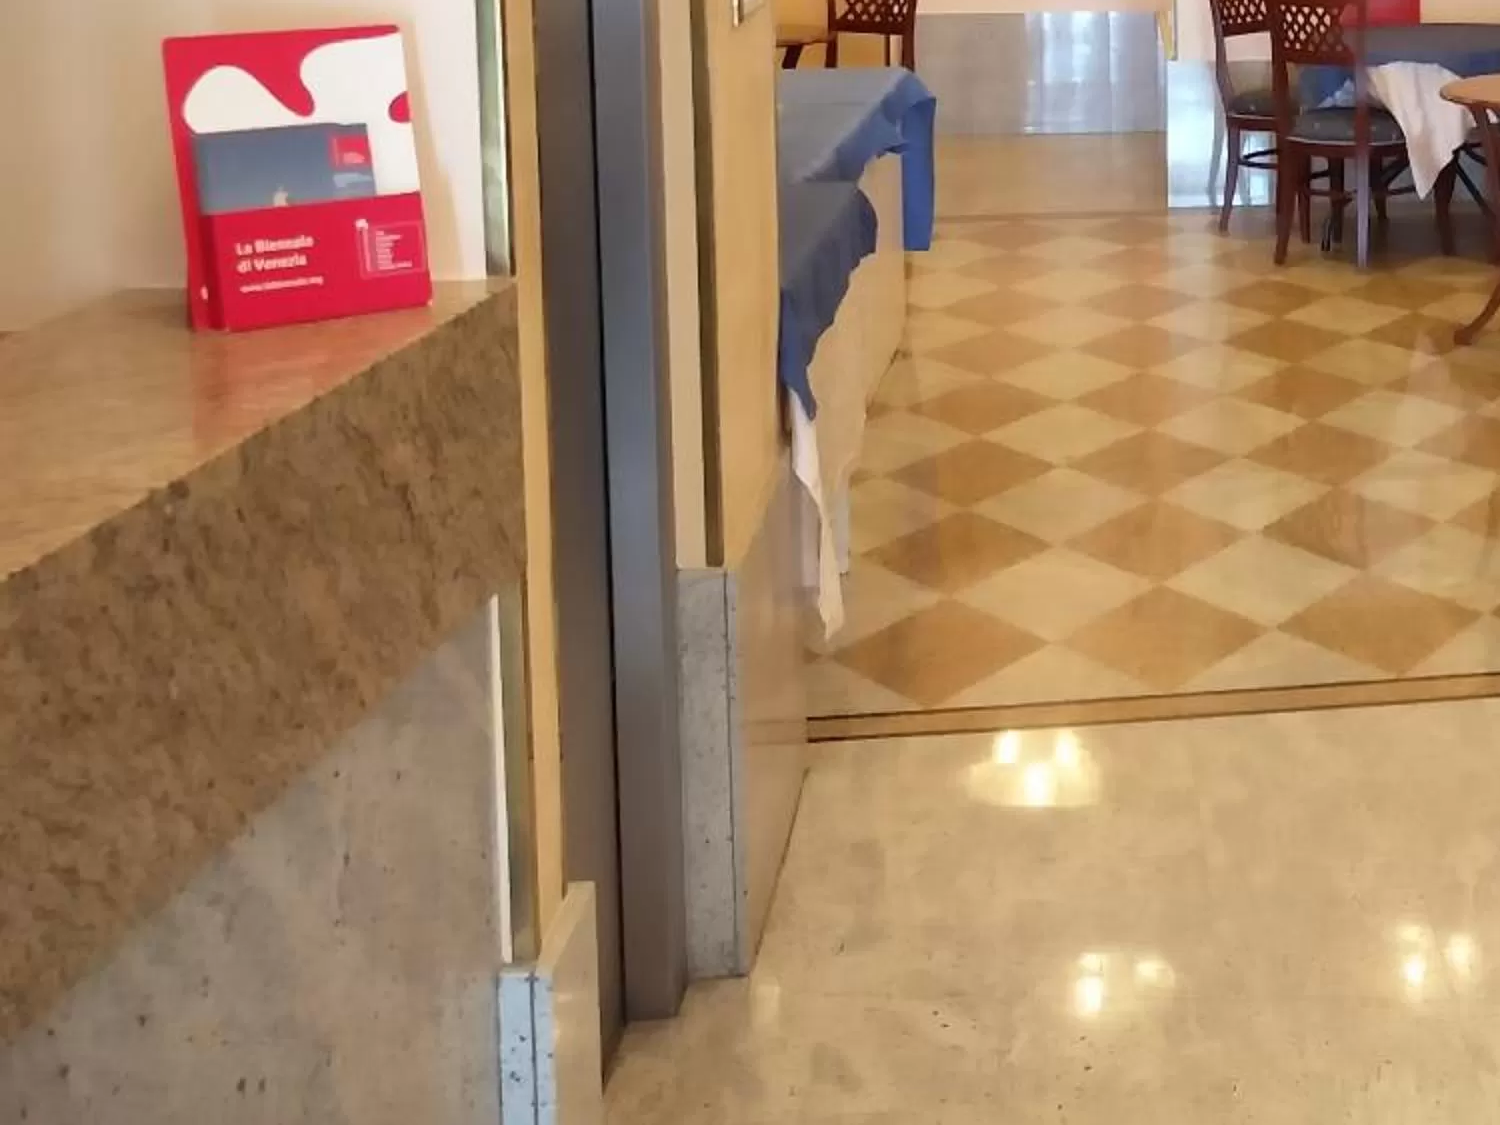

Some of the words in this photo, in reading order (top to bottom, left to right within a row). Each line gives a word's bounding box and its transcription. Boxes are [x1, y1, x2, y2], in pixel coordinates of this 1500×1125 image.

[235, 241, 254, 256] La
[254, 233, 315, 254] Biennale
[236, 258, 252, 274] di
[253, 252, 308, 272] Venezia
